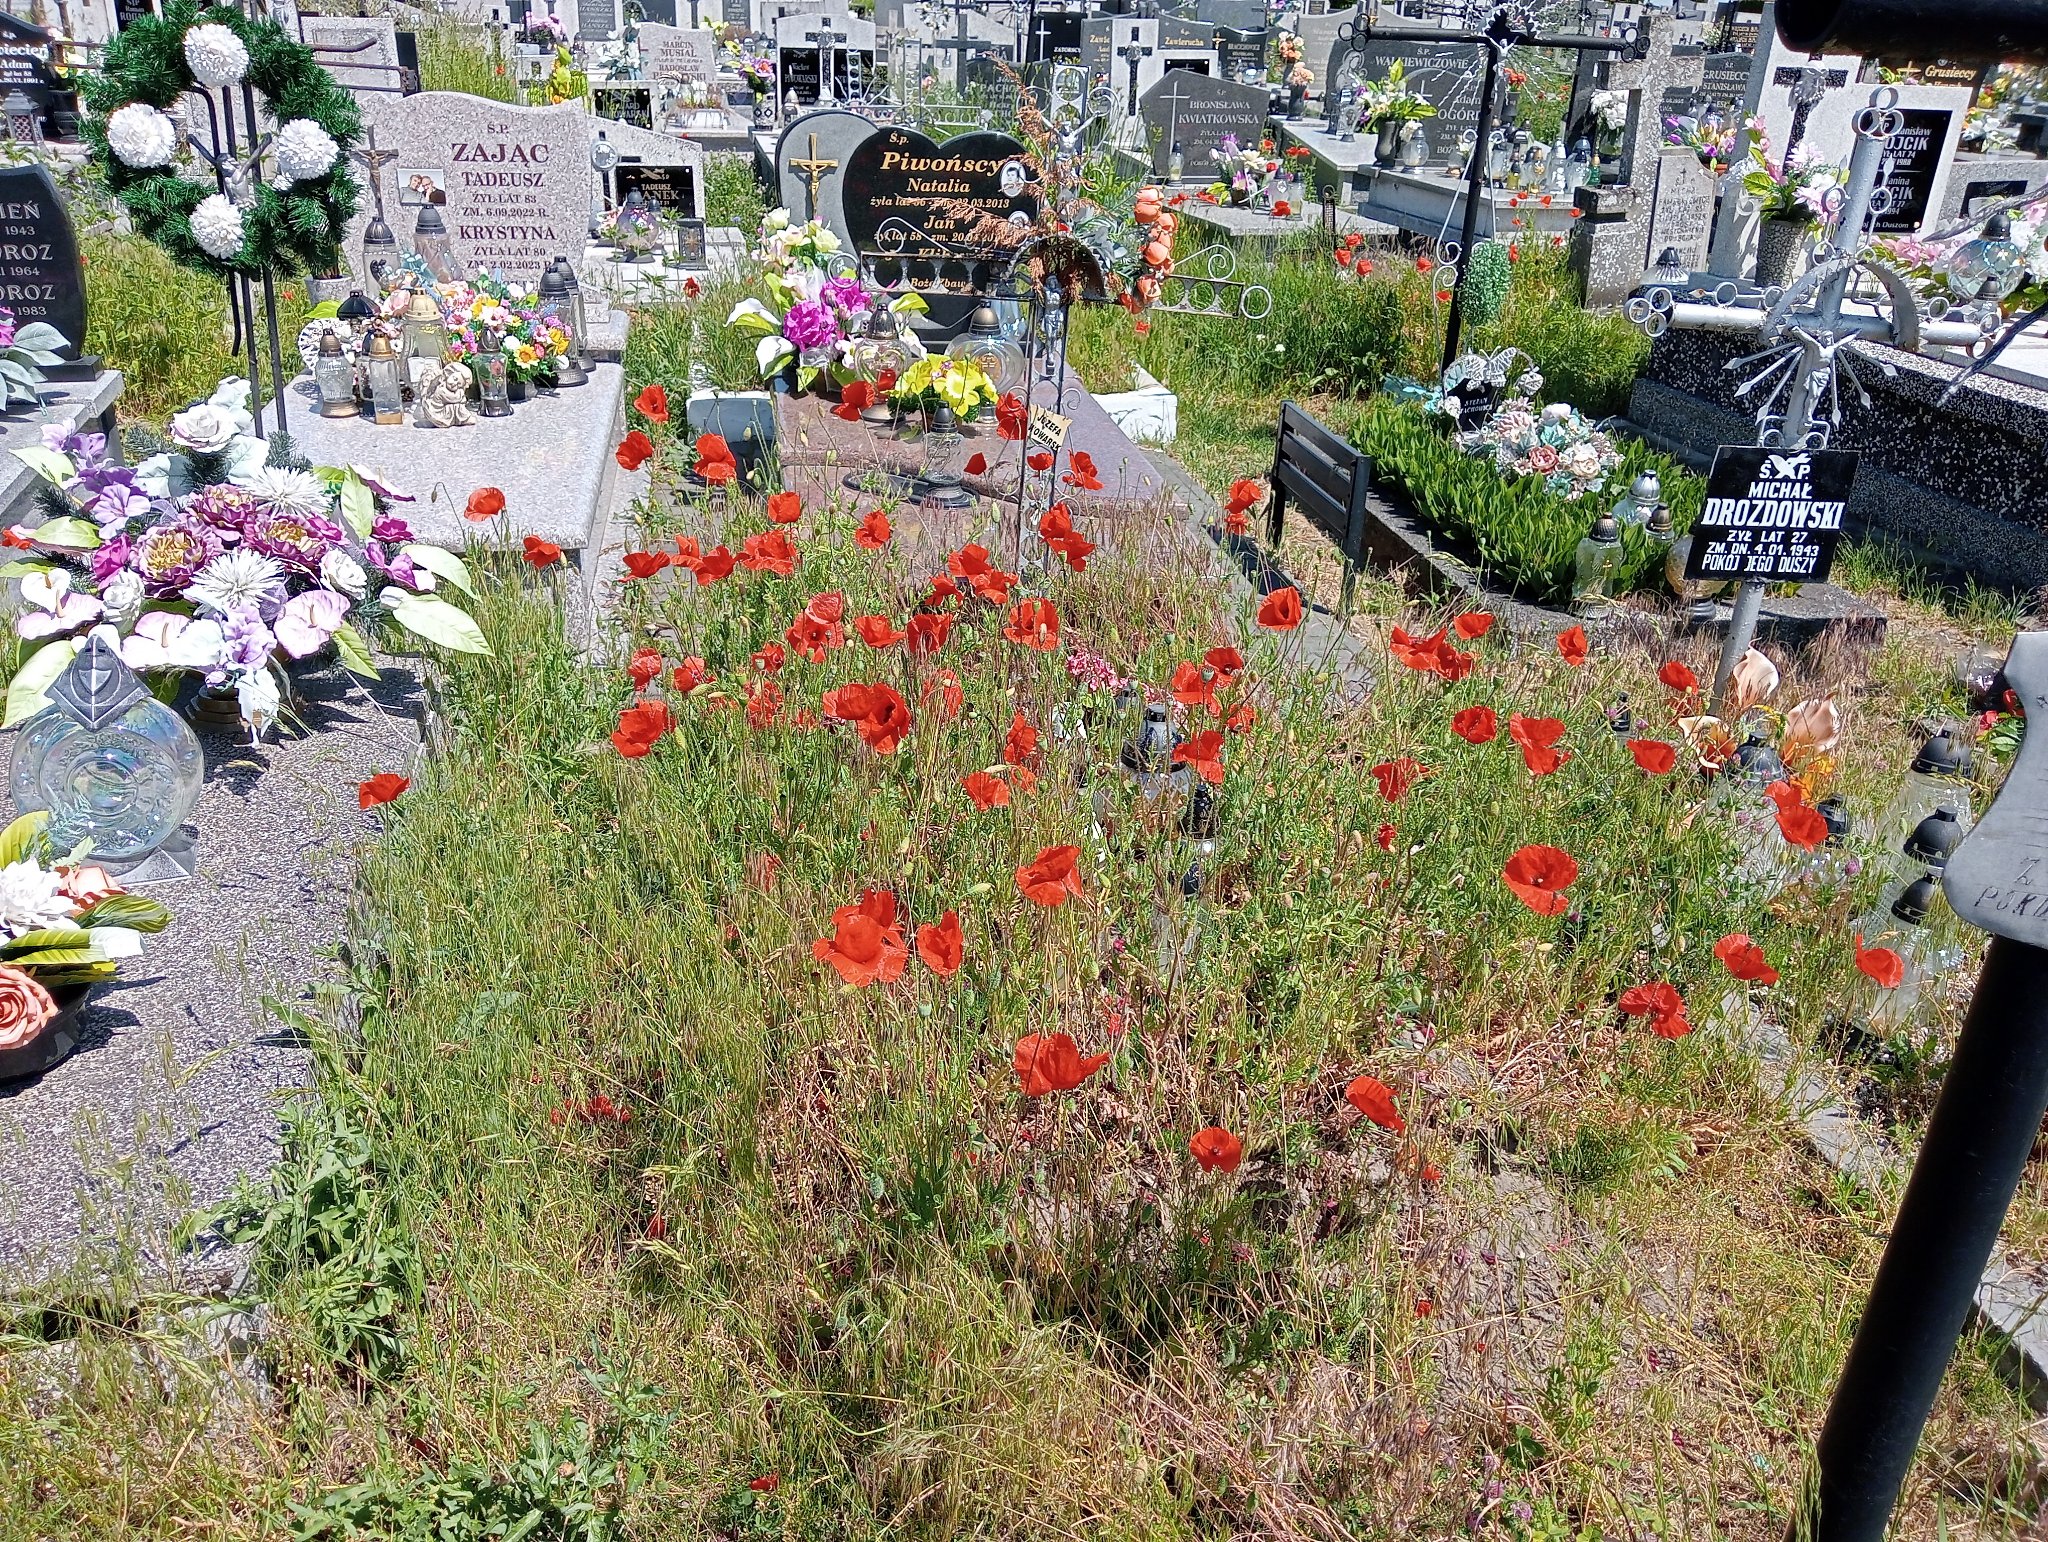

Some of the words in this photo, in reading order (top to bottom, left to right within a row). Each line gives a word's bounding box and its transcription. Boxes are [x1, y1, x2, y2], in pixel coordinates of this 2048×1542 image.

[1703, 69, 1750, 80] GRUSIECC
[1925, 64, 1978, 80] Grusieccy
[1178, 114, 1259, 124] KWIATKOWSKA
[889, 132, 909, 144] Ś.p.
[452, 143, 549, 168] ZAJĄC
[1893, 150, 1906, 158] LAT
[1907, 151, 1916, 159] 74
[880, 151, 1004, 177] Piwońscy
[462, 172, 543, 187] TADEUSZ
[906, 178, 971, 193] Natalia
[498, 193, 521, 203] LAT
[524, 195, 537, 203] 83
[462, 207, 483, 217] ZM.
[486, 208, 535, 217] 6.09.2022
[923, 216, 955, 230] Jan
[5, 225, 36, 236] 1943
[459, 225, 557, 240] KRYSTYNA
[909, 231, 922, 241] 58
[0, 243, 53, 261] ROZ
[507, 246, 530, 256] LAT
[533, 247, 546, 256] 80
[10, 266, 40, 276] 1964
[17, 306, 47, 316] 1983
[1748, 482, 1813, 499] MICHAŁ
[1700, 498, 1846, 530] DROZDOWSKI
[1760, 530, 1785, 543] LAT
[1791, 531, 1808, 543] 27
[1706, 541, 1728, 554] ZM.
[1730, 542, 1750, 555] DN.
[1701, 553, 1740, 571] POKÓJ
[1744, 556, 1774, 573] JEGO
[1778, 557, 1817, 574] DUSZY
